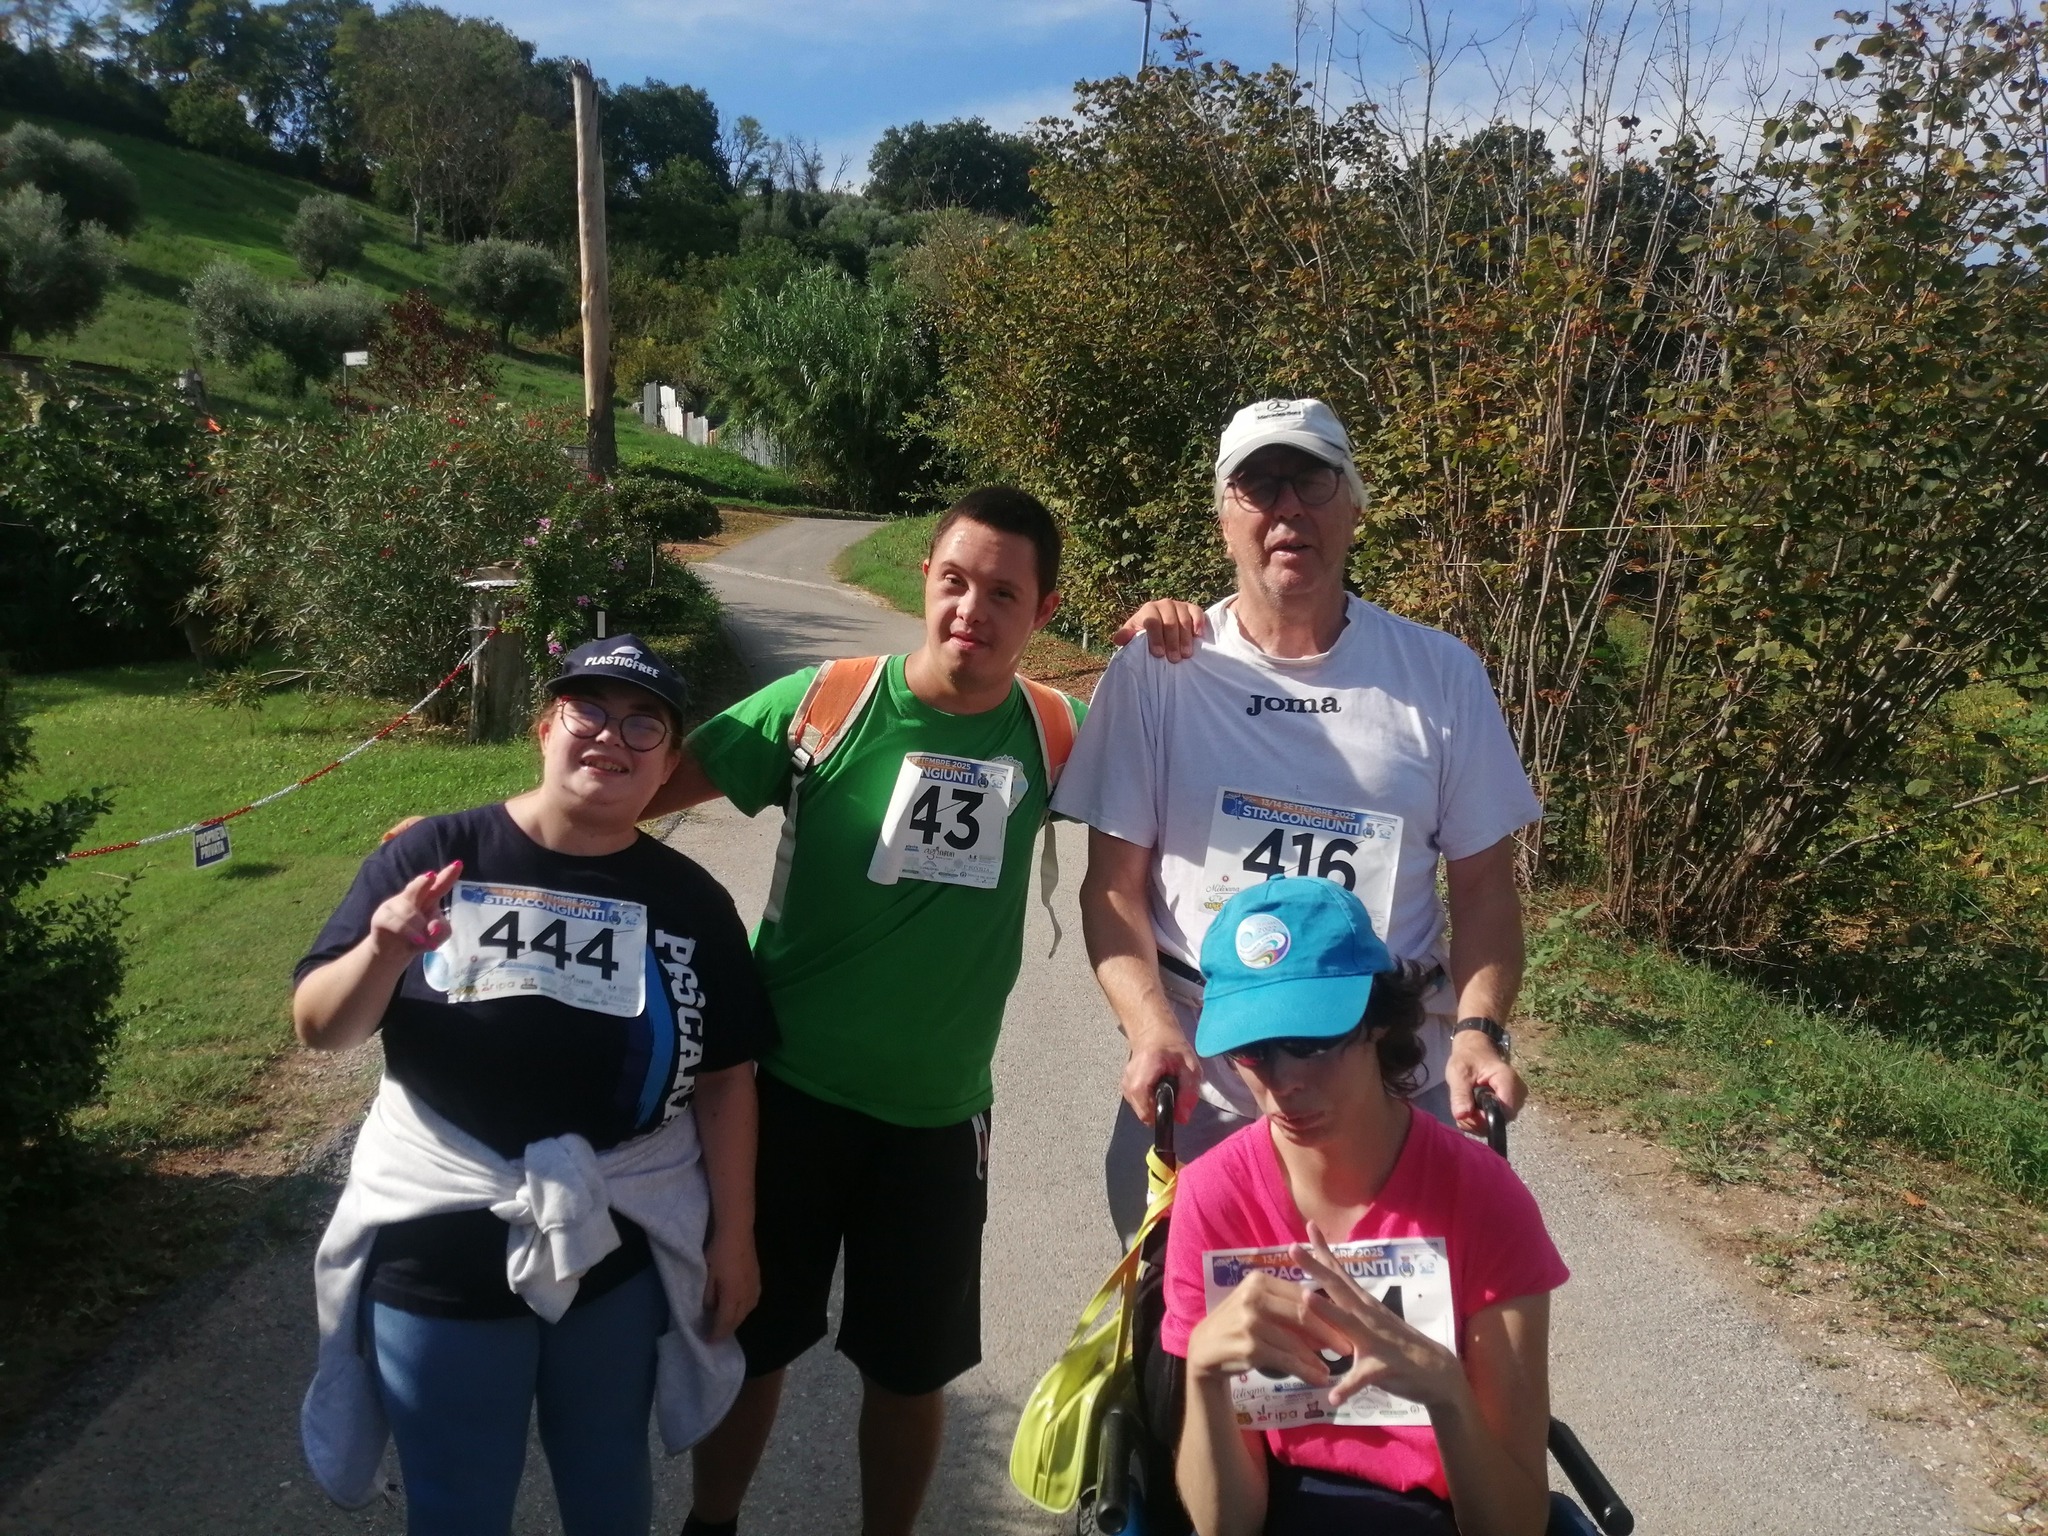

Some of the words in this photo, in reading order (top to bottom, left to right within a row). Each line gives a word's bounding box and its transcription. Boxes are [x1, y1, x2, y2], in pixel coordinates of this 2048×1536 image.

[1246, 695, 1341, 716] Joma
[952, 761, 971, 770] 2025
[909, 785, 984, 850] 43
[1243, 805, 1360, 834] STRACONGIUNTI
[1262, 798, 1283, 808] 13/14
[1284, 802, 1334, 815] SETTEMBRE
[1335, 810, 1356, 820] 2025
[1243, 828, 1358, 891] 416
[484, 895, 606, 921] STRACONGIUNTI
[580, 899, 601, 908] 2025
[479, 910, 619, 981] 444
[1356, 1247, 1385, 1257] 2025
